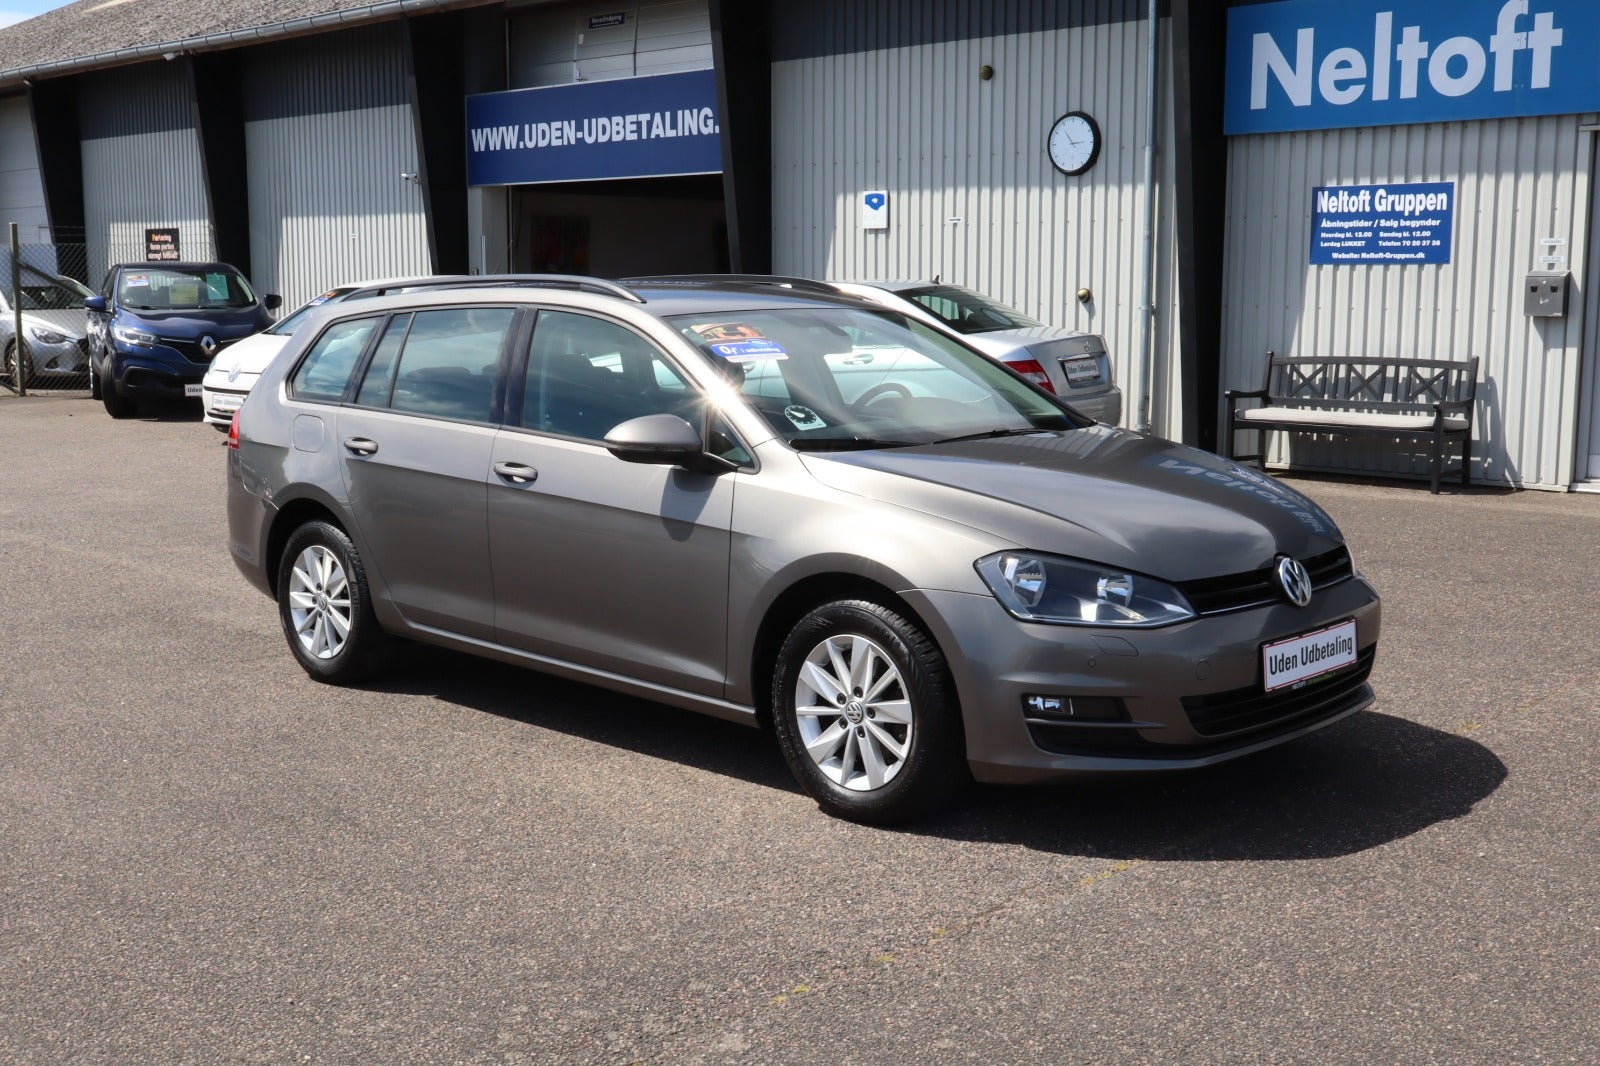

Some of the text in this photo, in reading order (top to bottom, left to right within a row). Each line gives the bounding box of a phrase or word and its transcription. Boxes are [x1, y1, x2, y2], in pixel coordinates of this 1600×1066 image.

[1250, 0, 1563, 110] Neltoft
[1316, 188, 1448, 216] Neltoft Gruppen
[1321, 218, 1441, 229] Åbningstider / Salg begynder
[1269, 636, 1353, 676] Uden Udbetaling
